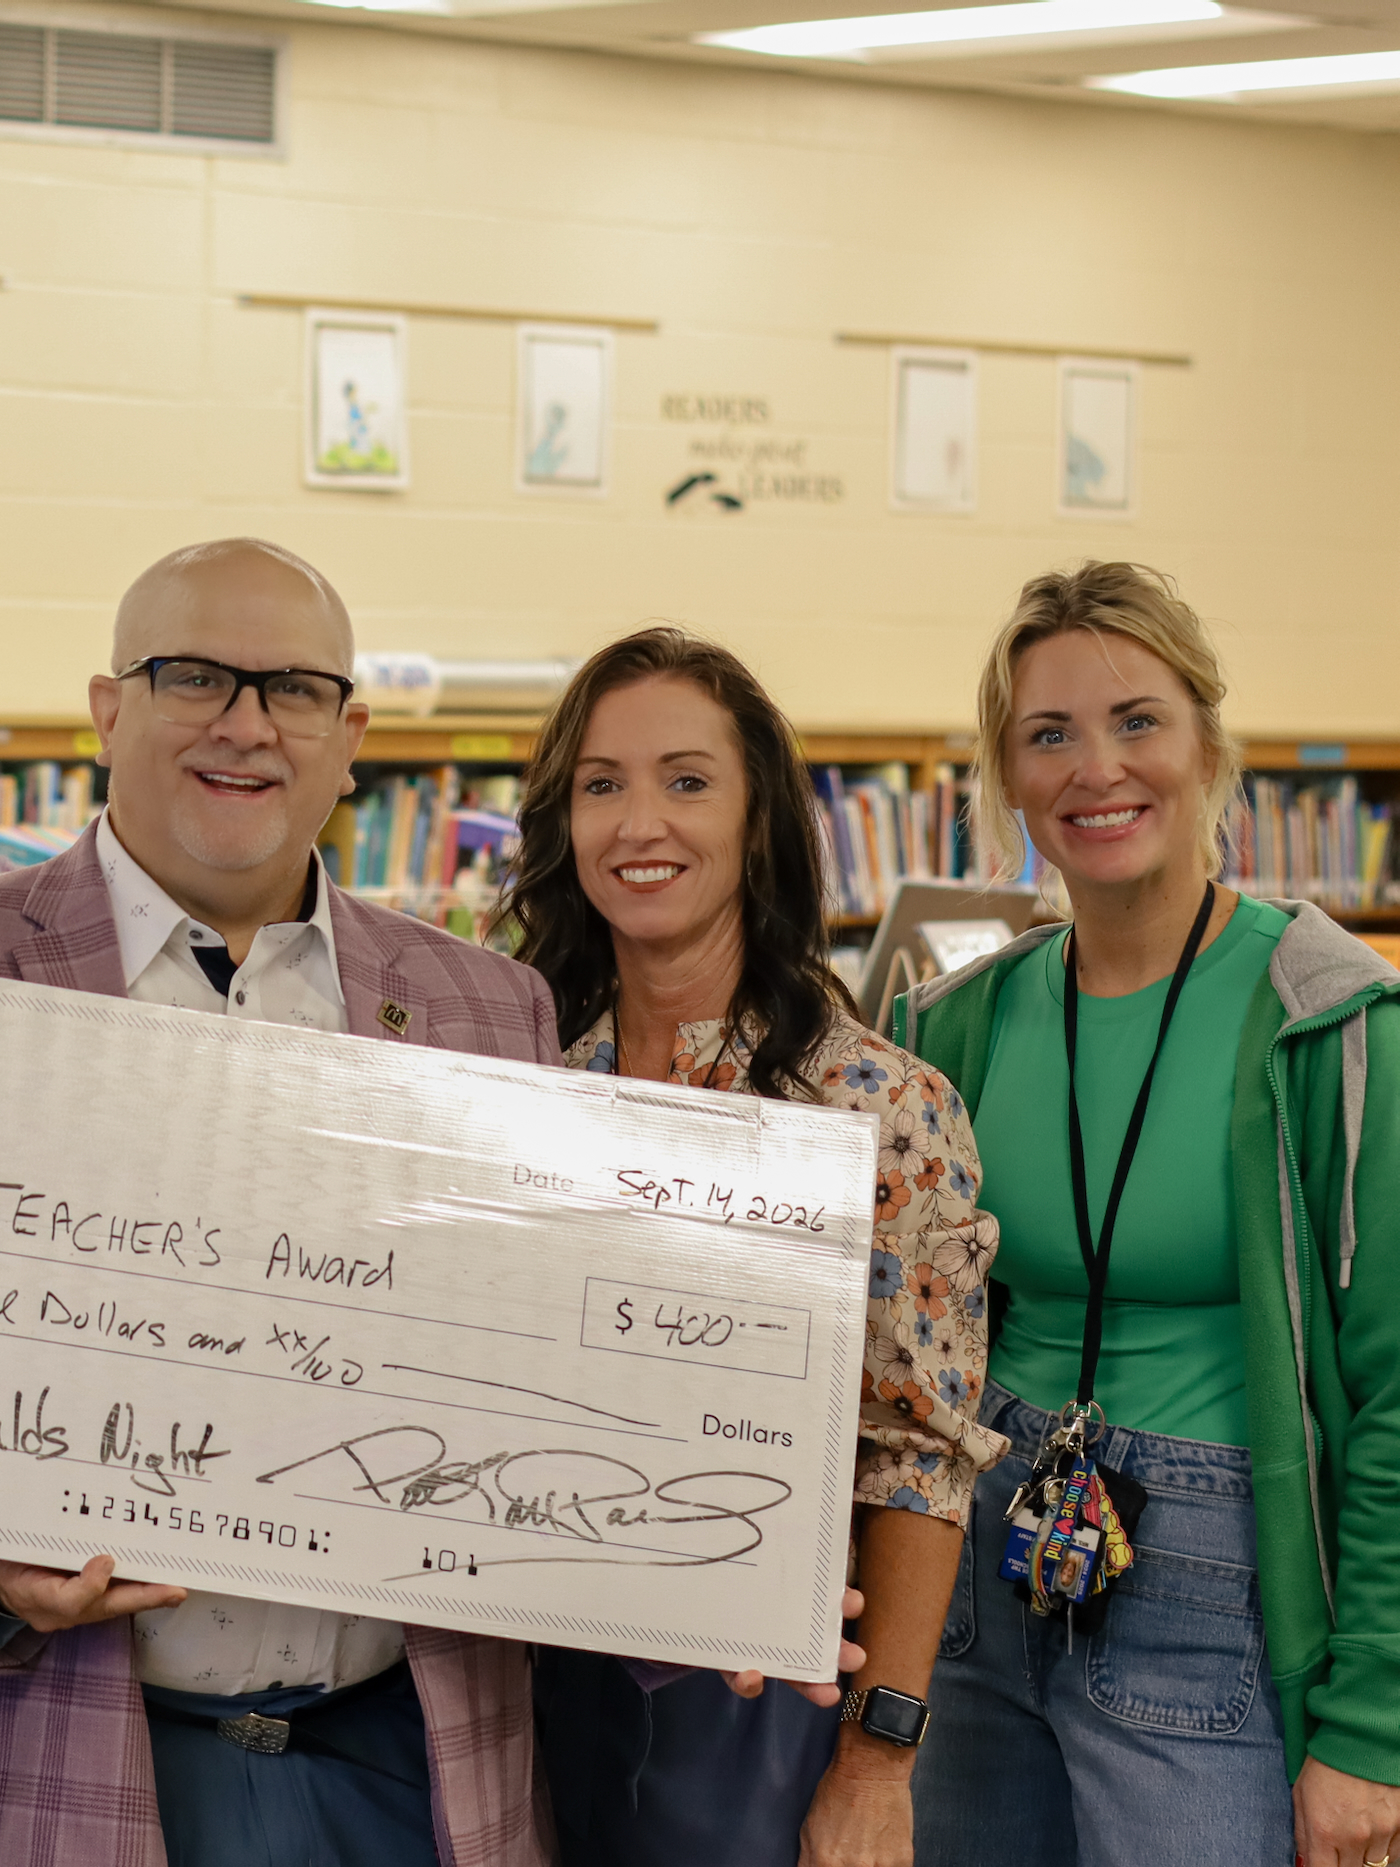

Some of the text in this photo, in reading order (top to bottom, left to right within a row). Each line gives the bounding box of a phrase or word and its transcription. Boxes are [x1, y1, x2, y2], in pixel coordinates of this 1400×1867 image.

[512, 1163, 575, 1194] Date
[746, 1196, 826, 1233] 2026
[265, 1232, 394, 1292] Award
[40, 1290, 167, 1349] Dollars
[188, 1332, 247, 1356] and
[615, 1297, 634, 1336] $
[99, 1402, 232, 1498] Night
[702, 1412, 794, 1448] Dollars
[1043, 1470, 1089, 1560] choose kind
